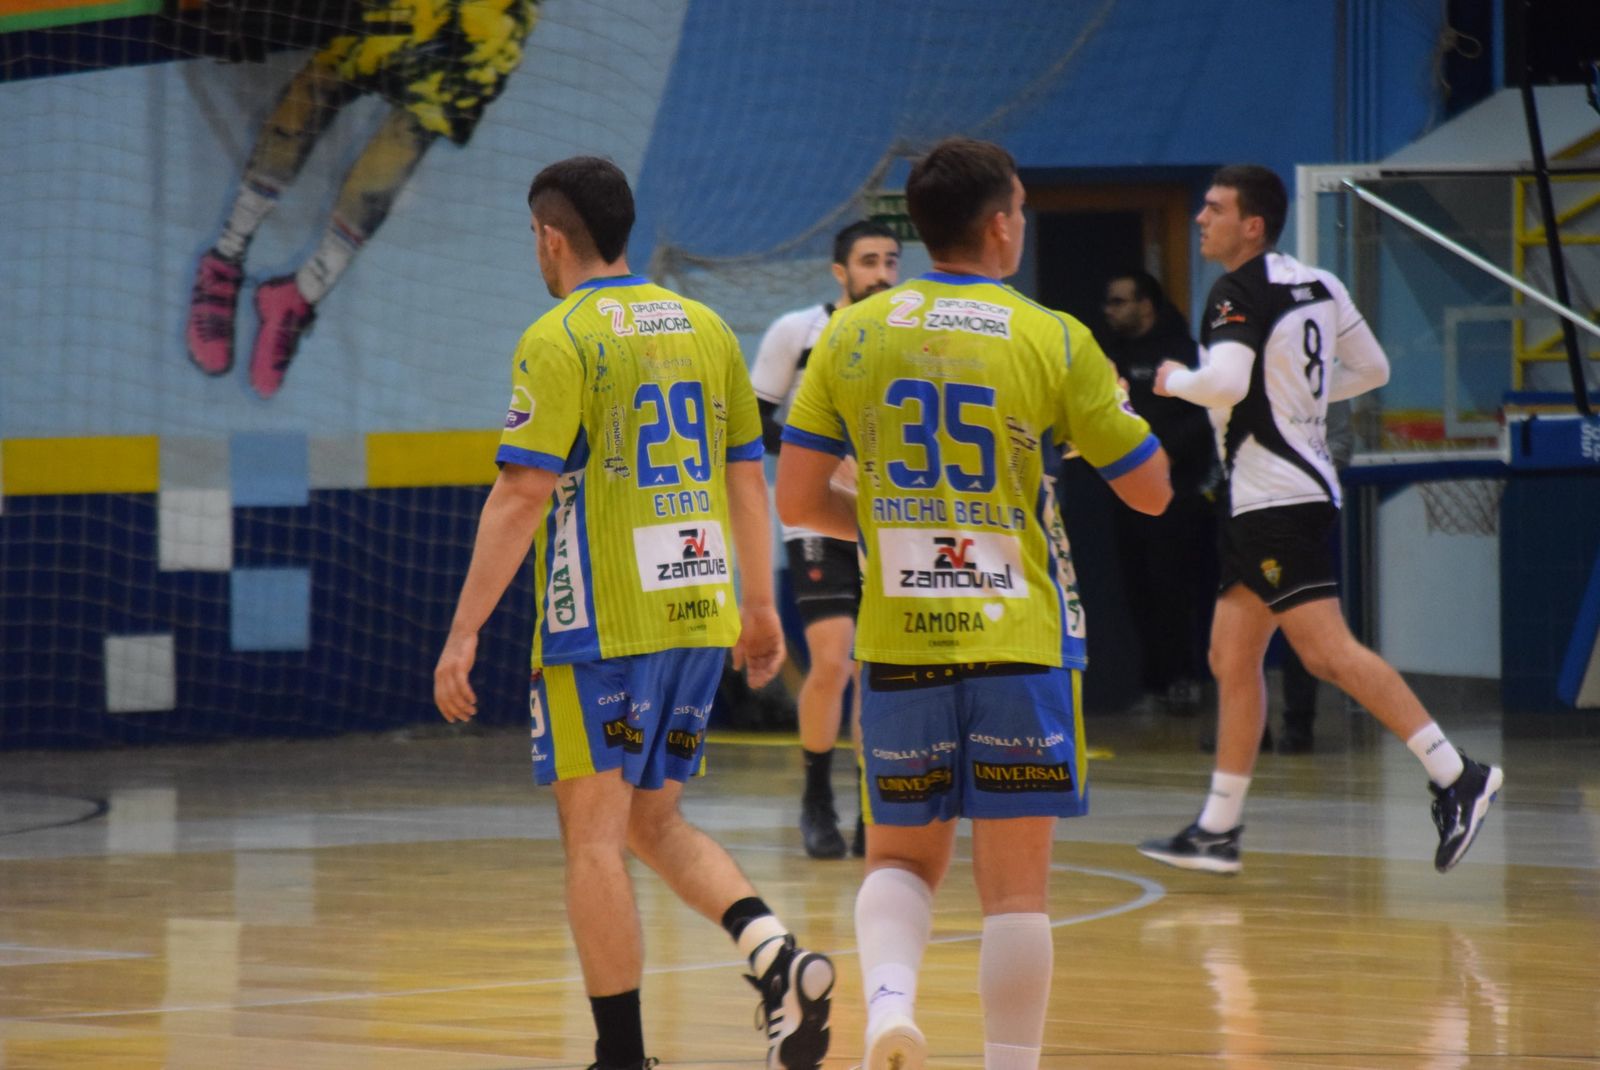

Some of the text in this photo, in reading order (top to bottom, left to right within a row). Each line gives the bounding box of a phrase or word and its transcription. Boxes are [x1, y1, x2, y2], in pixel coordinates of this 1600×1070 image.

[634, 317, 693, 334] ZAMORA
[926, 313, 1009, 336] ZAMORA
[1304, 318, 1324, 399] 8
[633, 381, 712, 489] 29
[885, 378, 996, 493] 35
[654, 490, 711, 517] ETAYO
[873, 498, 948, 522] ANCHO
[657, 559, 727, 581] zamovia
[900, 564, 1013, 590] zamovial
[553, 565, 577, 625] CAJA
[667, 598, 719, 622] ZAMORA
[904, 611, 985, 633] ZAMORA
[598, 691, 626, 706] CAST
[969, 733, 1022, 748] CASTILLA
[1026, 736, 1036, 748] Y
[975, 764, 1069, 781] UNIVERSAL
